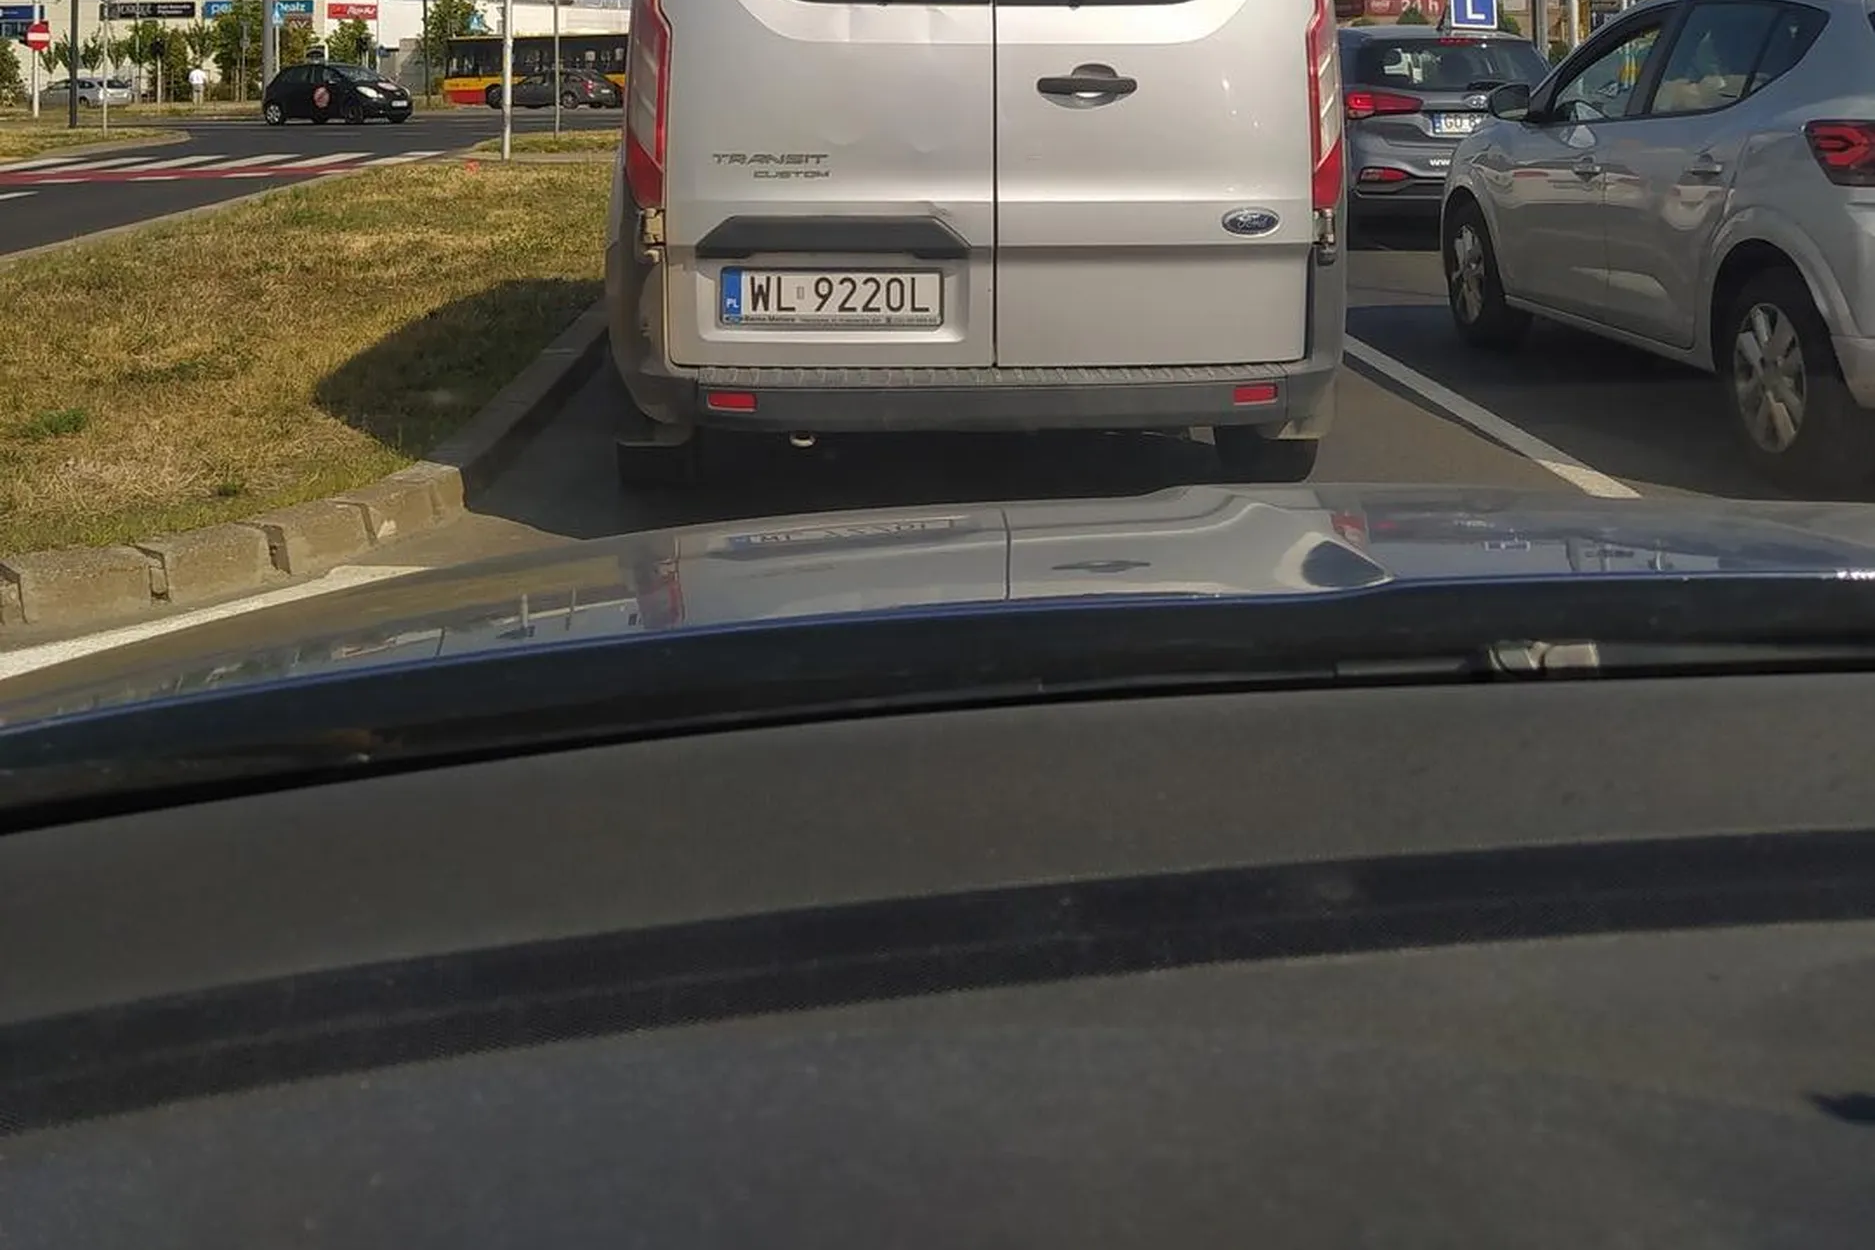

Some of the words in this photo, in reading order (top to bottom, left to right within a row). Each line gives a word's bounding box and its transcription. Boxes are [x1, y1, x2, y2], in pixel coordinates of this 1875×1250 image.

[712, 153, 830, 166] TRANSIT
[753, 170, 831, 179] CUSTOM
[750, 275, 797, 313] WL
[813, 275, 931, 313] 9220L
